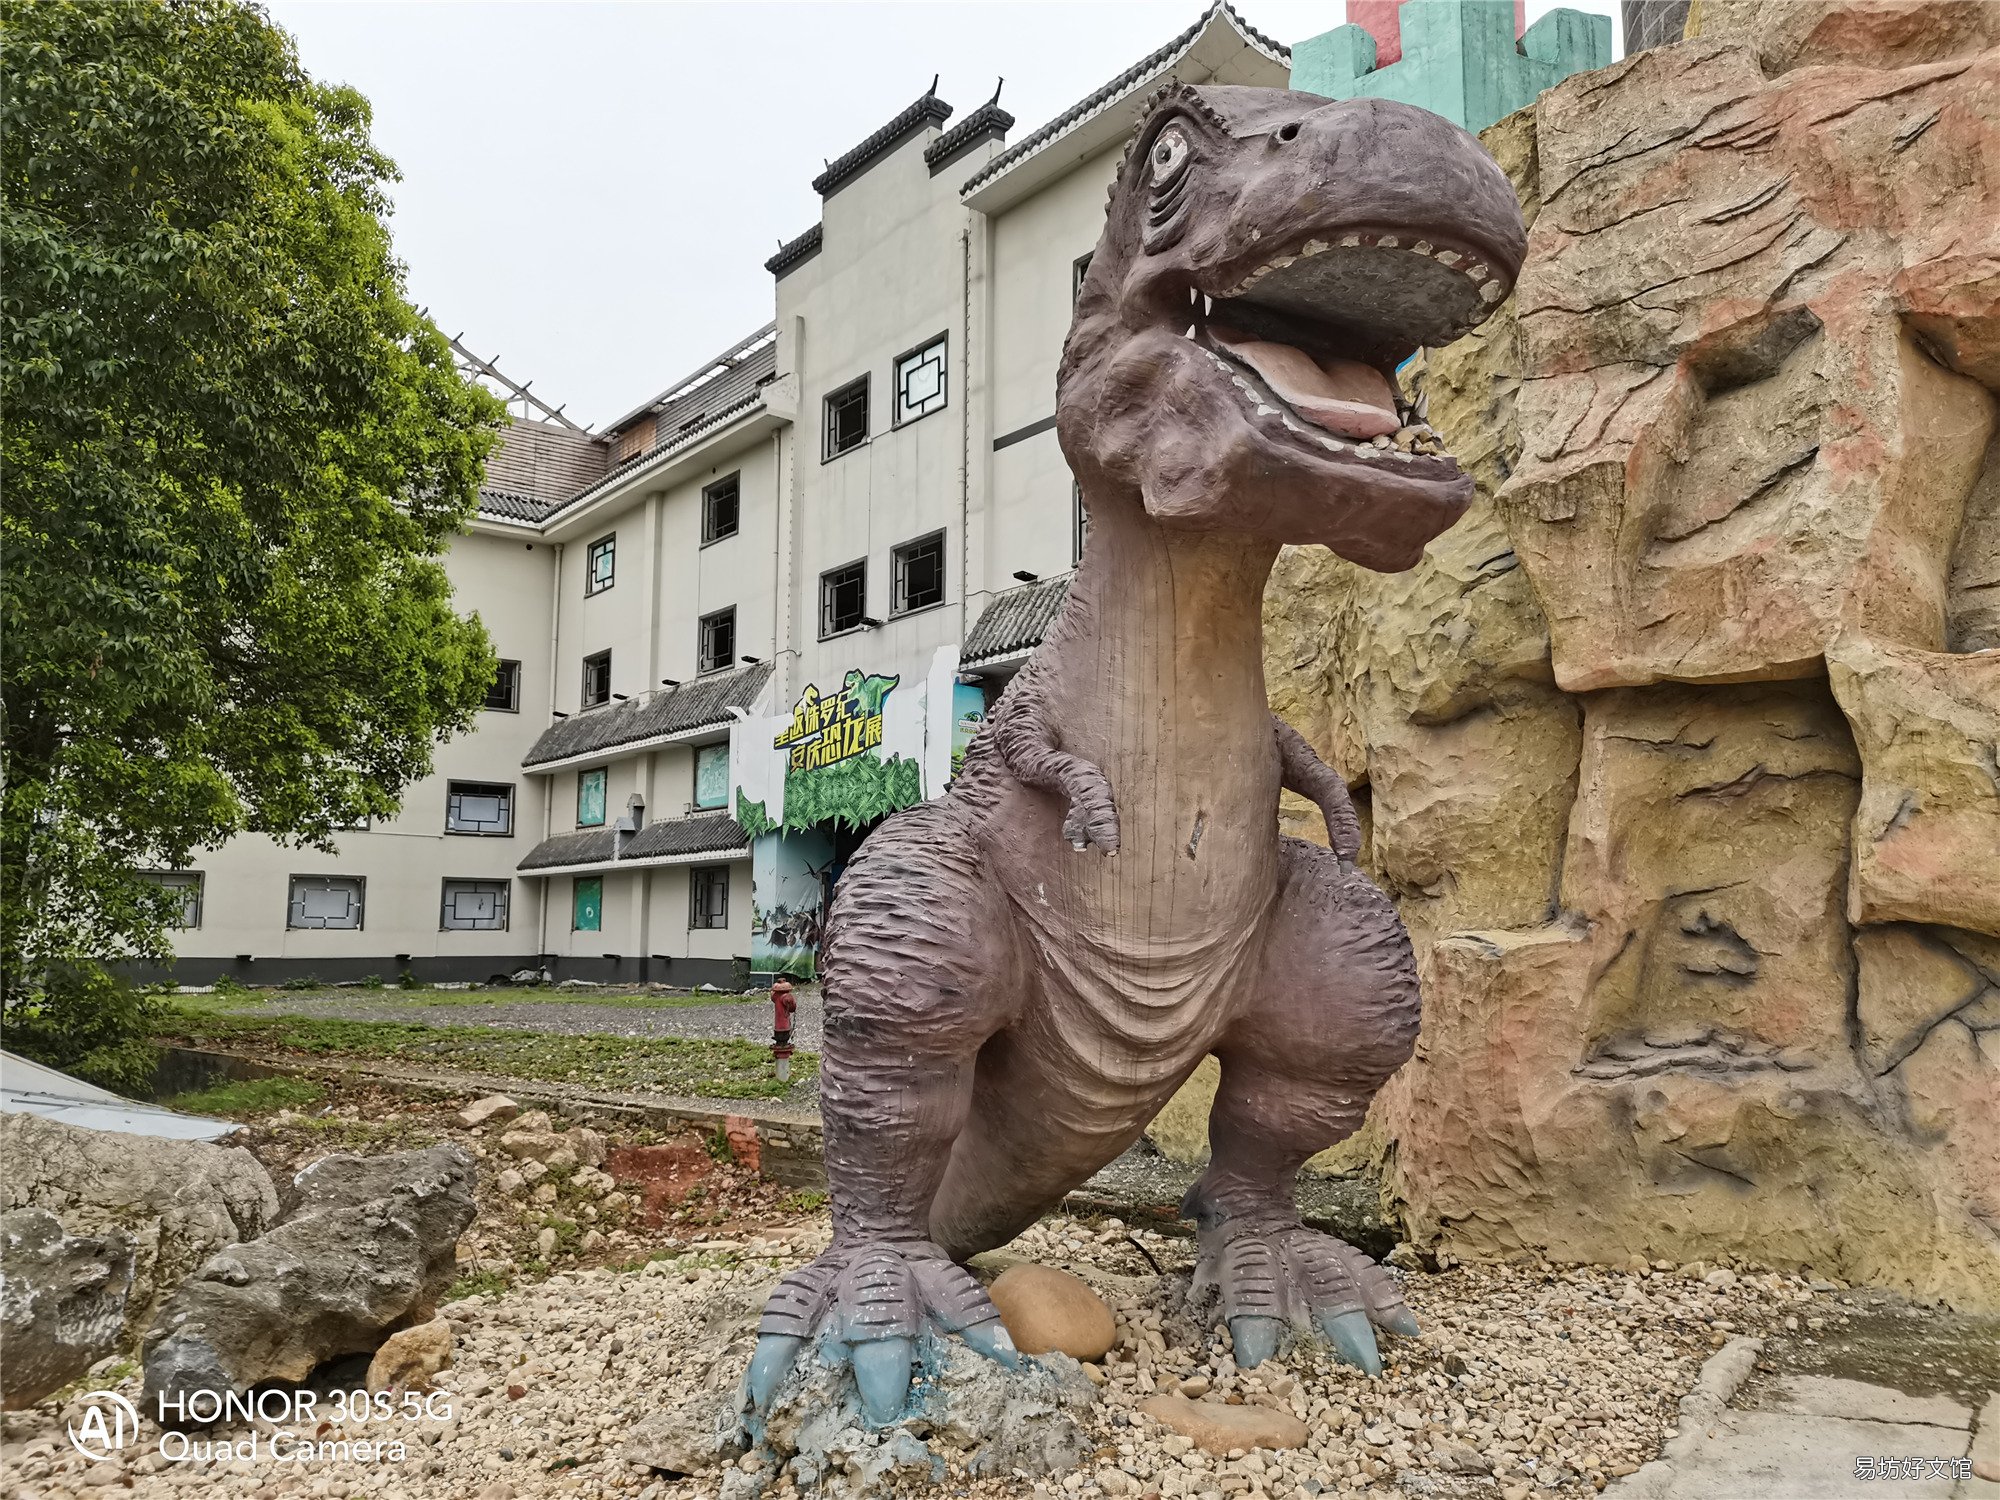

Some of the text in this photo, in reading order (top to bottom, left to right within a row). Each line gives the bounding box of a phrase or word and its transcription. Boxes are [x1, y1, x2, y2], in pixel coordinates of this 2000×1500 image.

[791, 712, 881, 774] 安庆恐龙展
